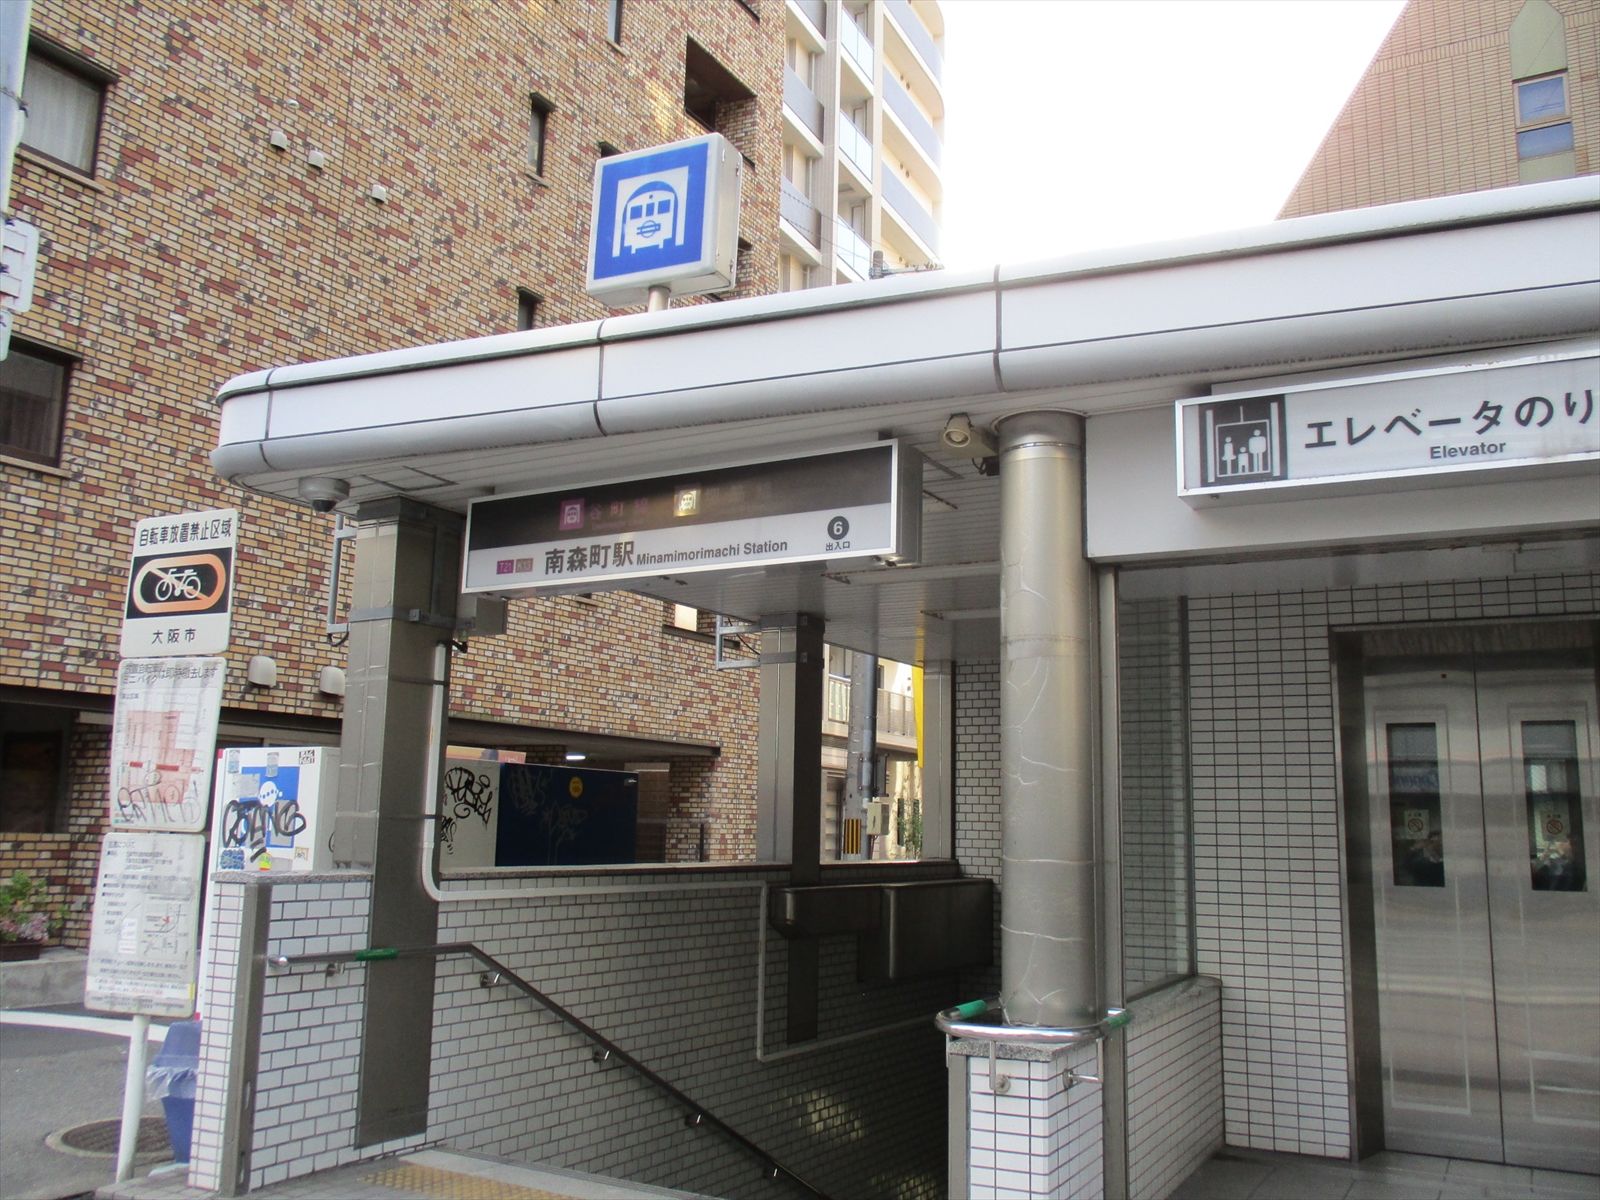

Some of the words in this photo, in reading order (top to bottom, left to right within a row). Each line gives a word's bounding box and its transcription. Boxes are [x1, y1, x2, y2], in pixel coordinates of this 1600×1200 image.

[1304, 389, 1594, 449] エレベータのり
[1429, 440, 1507, 460] Elevator
[139, 517, 232, 547] 自転車放置禁止区域
[544, 540, 635, 575] 南森町駅
[636, 543, 740, 566] Minamimorimachi
[743, 540, 788, 555] Station
[825, 540, 851, 552] 出入口
[151, 627, 196, 645] 大阪市
